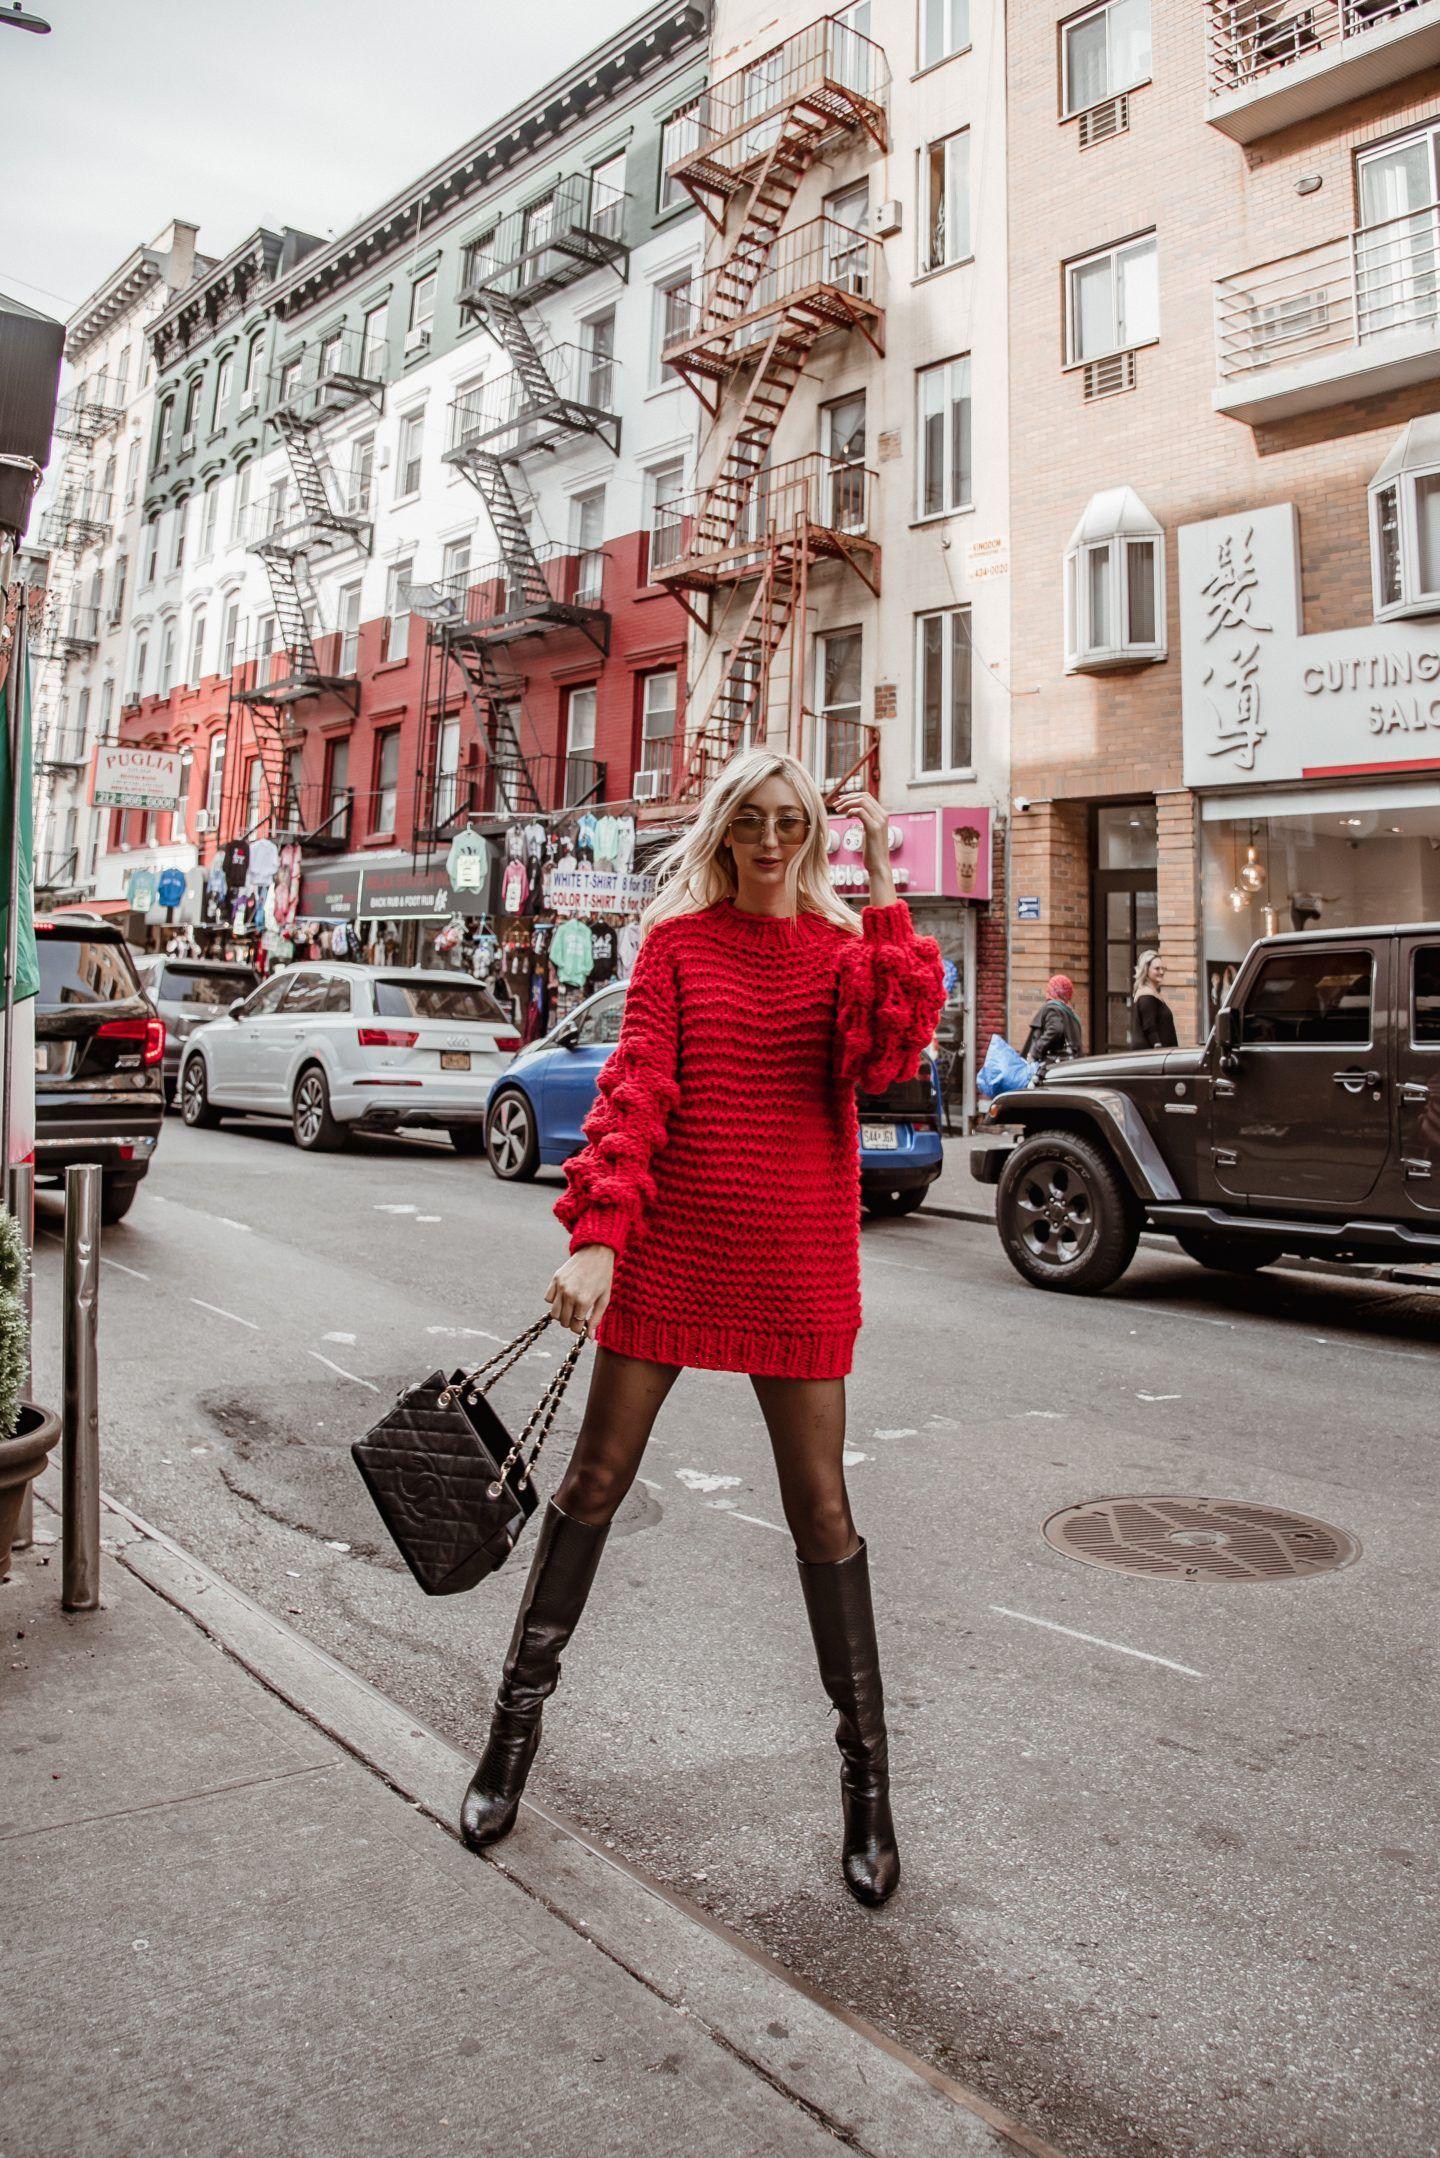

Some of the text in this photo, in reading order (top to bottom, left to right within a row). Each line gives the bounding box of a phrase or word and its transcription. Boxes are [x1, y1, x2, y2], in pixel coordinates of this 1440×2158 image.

[1303, 649, 1440, 694] CUTTING
[106, 753, 173, 774] PUGLIA
[554, 873, 581, 887] WHITE
[584, 874, 618, 890] T-SHIRT
[629, 877, 640, 893] for
[404, 895, 421, 908] FOOT
[552, 892, 581, 907] COLOR
[584, 893, 616, 909] T-SHIRT
